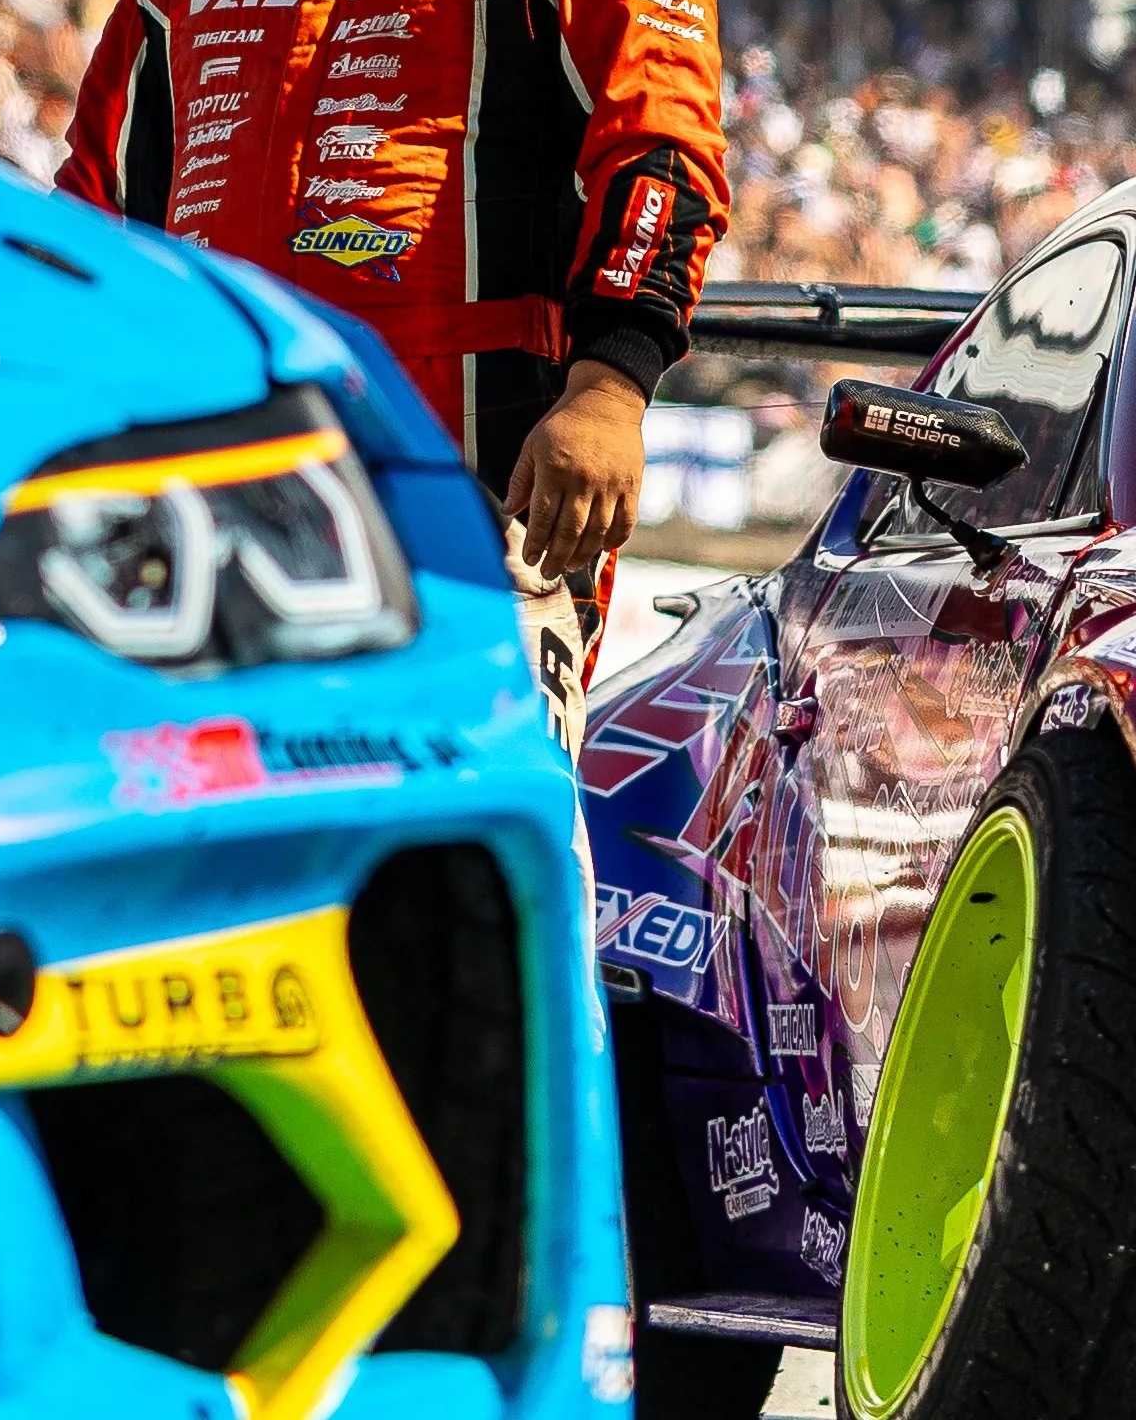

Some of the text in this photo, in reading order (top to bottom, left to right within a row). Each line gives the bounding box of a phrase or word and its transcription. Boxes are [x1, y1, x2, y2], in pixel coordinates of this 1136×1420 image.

[192, 29, 264, 49] DIGICAM
[186, 92, 241, 121] TOPTUL
[295, 232, 402, 253] SUNOCO
[895, 410, 945, 430] craft
[892, 422, 961, 448] square
